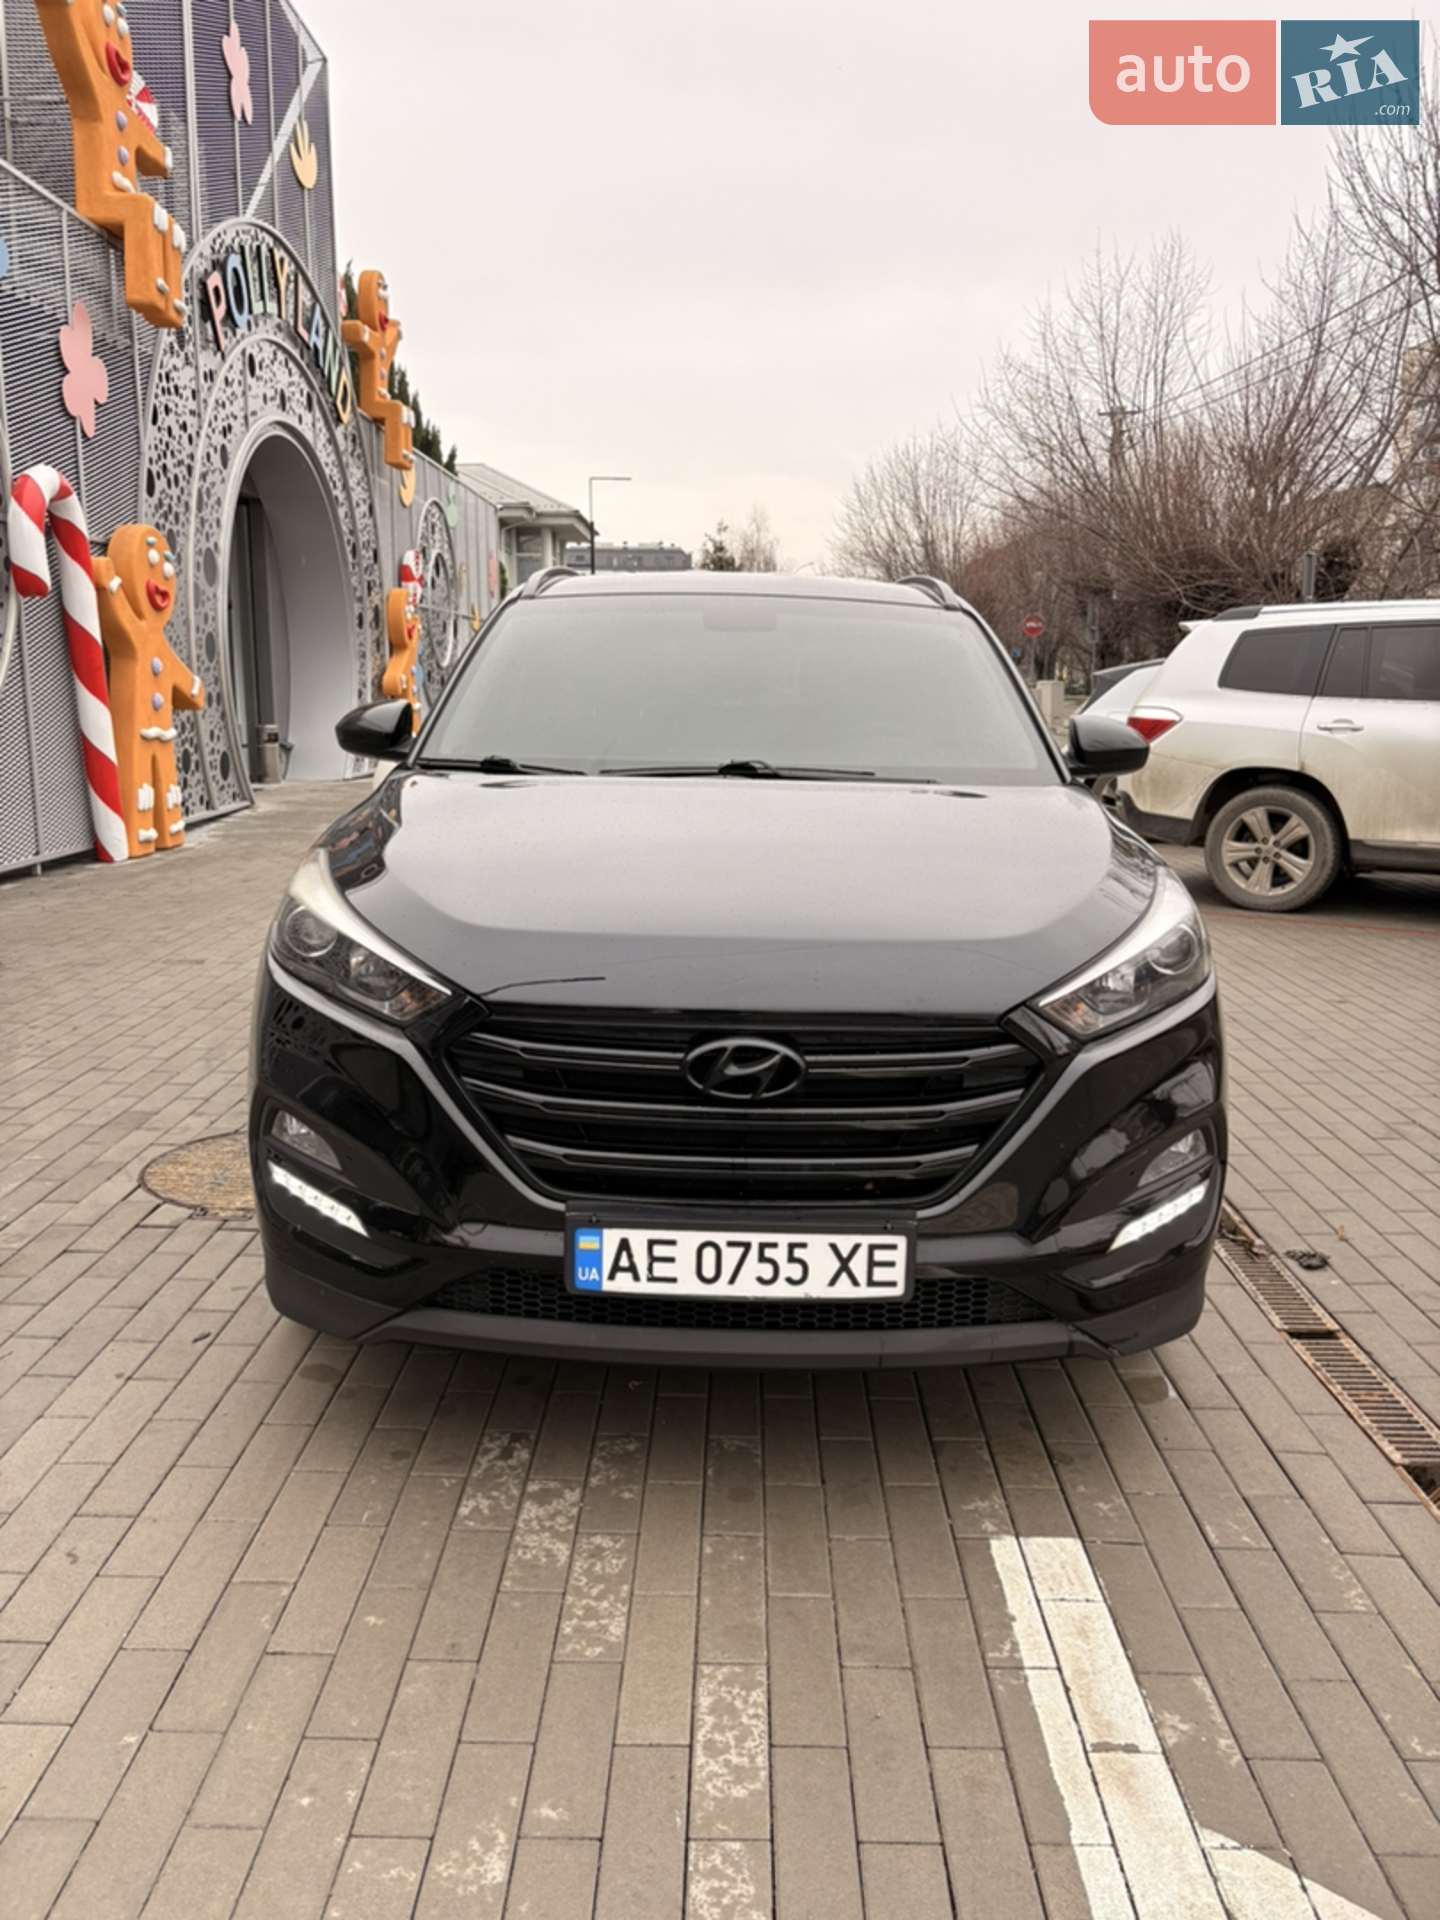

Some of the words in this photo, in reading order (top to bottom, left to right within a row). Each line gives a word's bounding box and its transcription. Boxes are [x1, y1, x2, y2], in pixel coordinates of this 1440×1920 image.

[206, 245, 288, 351] POLLY
[297, 274, 351, 424] LAND
[577, 1266, 599, 1281] UA
[607, 1237, 678, 1283] AE
[695, 1240, 809, 1286] 0755
[827, 1242, 898, 1287] XE
